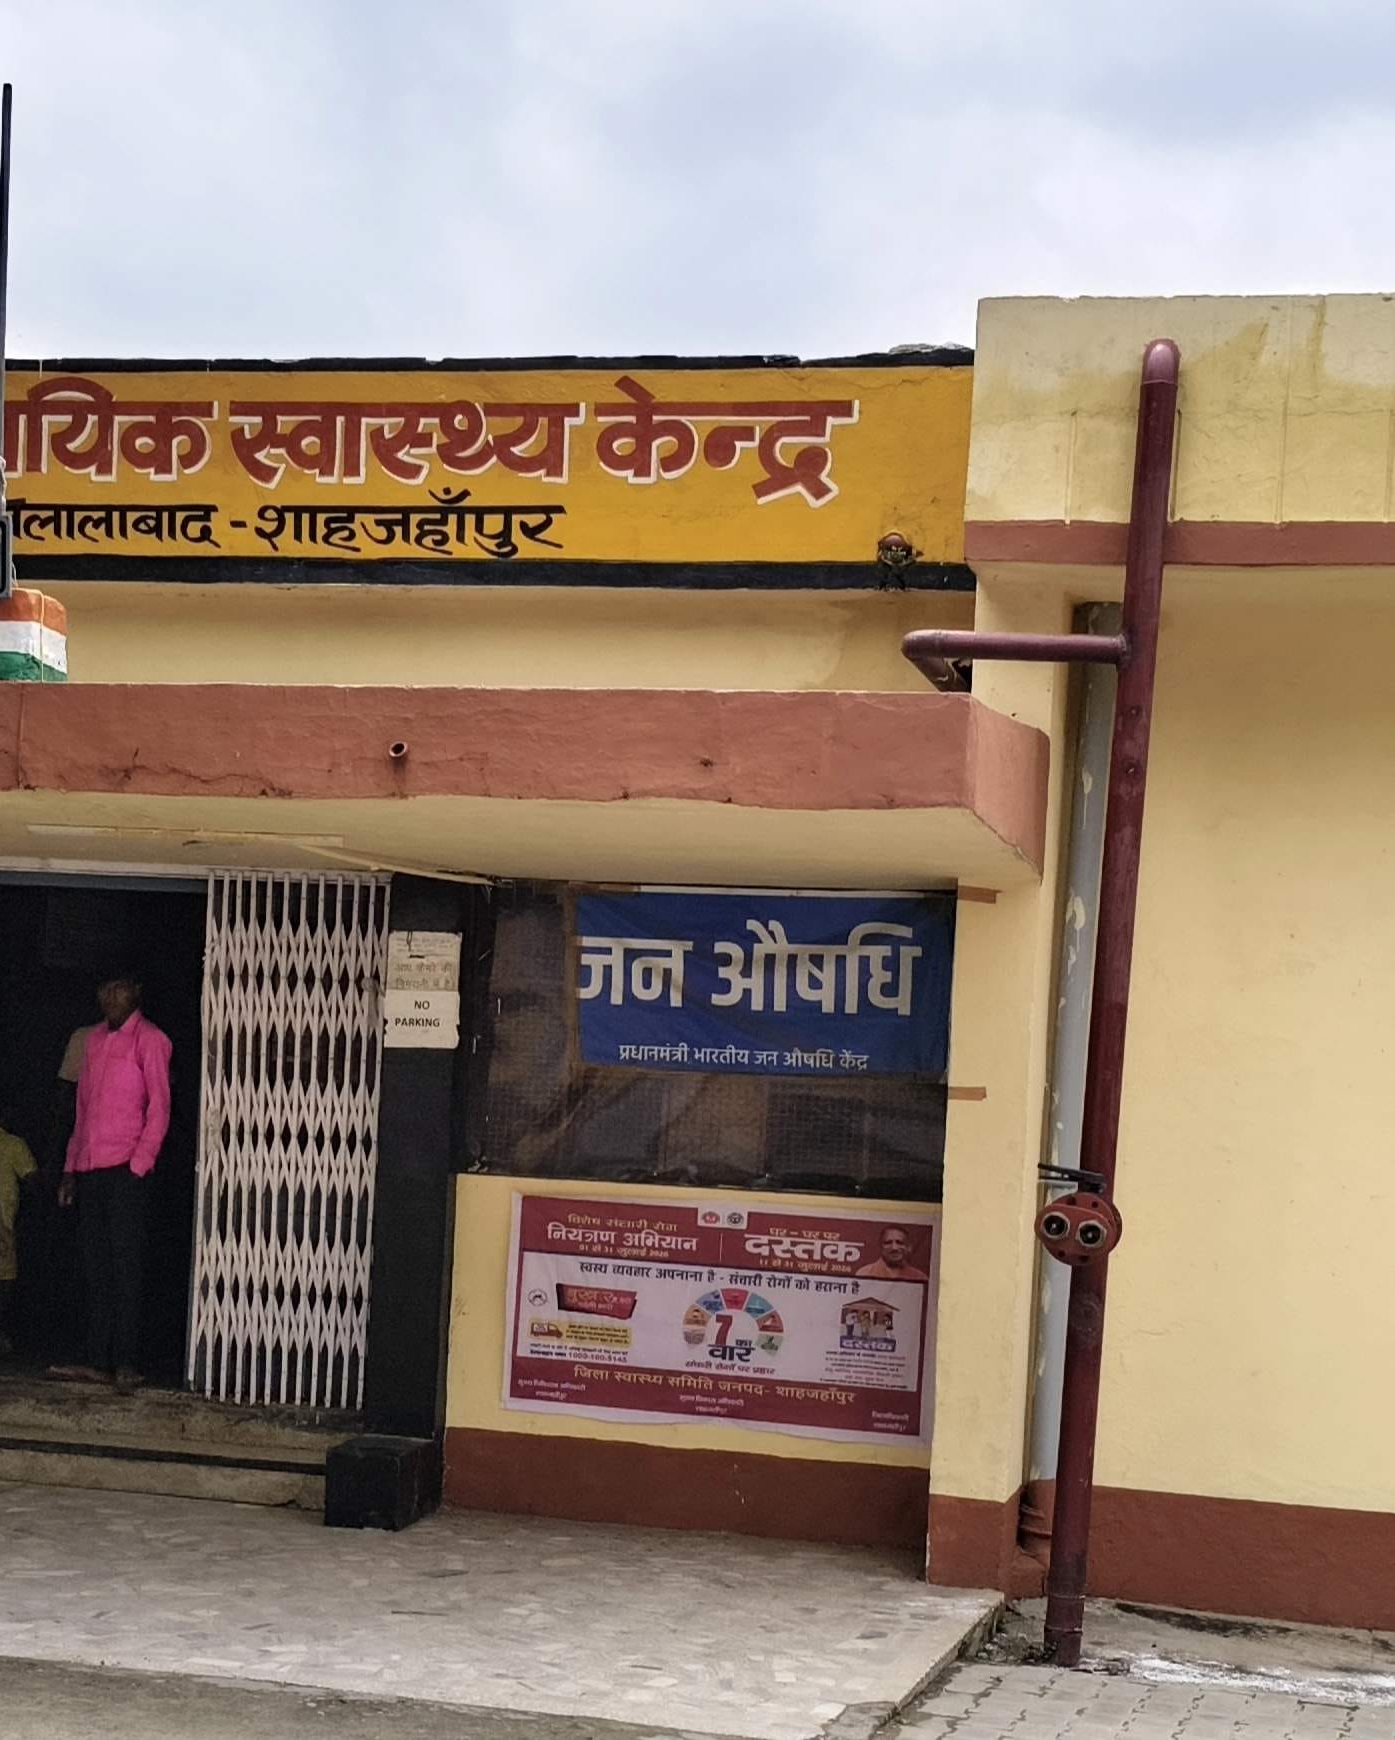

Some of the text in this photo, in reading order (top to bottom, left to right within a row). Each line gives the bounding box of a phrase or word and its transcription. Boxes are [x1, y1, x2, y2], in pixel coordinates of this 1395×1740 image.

[230, 400, 585, 488] स्वास्थ्य
[594, 374, 859, 508] केन्द्र
[573, 919, 922, 1017] जन औषधि
[414, 1000, 431, 1010] NO
[394, 1017, 441, 1028] PARKING
[619, 1042, 870, 1072] प्रधानमंत्री भारतीय जन औषधि केंद्र
[622, 1229, 699, 1251] अभियान
[744, 1233, 865, 1262] दस्तक
[656, 1268, 704, 1283] अपनाना
[715, 1314, 733, 1346] 7
[708, 1343, 756, 1362] वार
[573, 1364, 610, 1380] जिला
[614, 1370, 664, 1386] स्वास्थ्य
[668, 1374, 713, 1392] समिति
